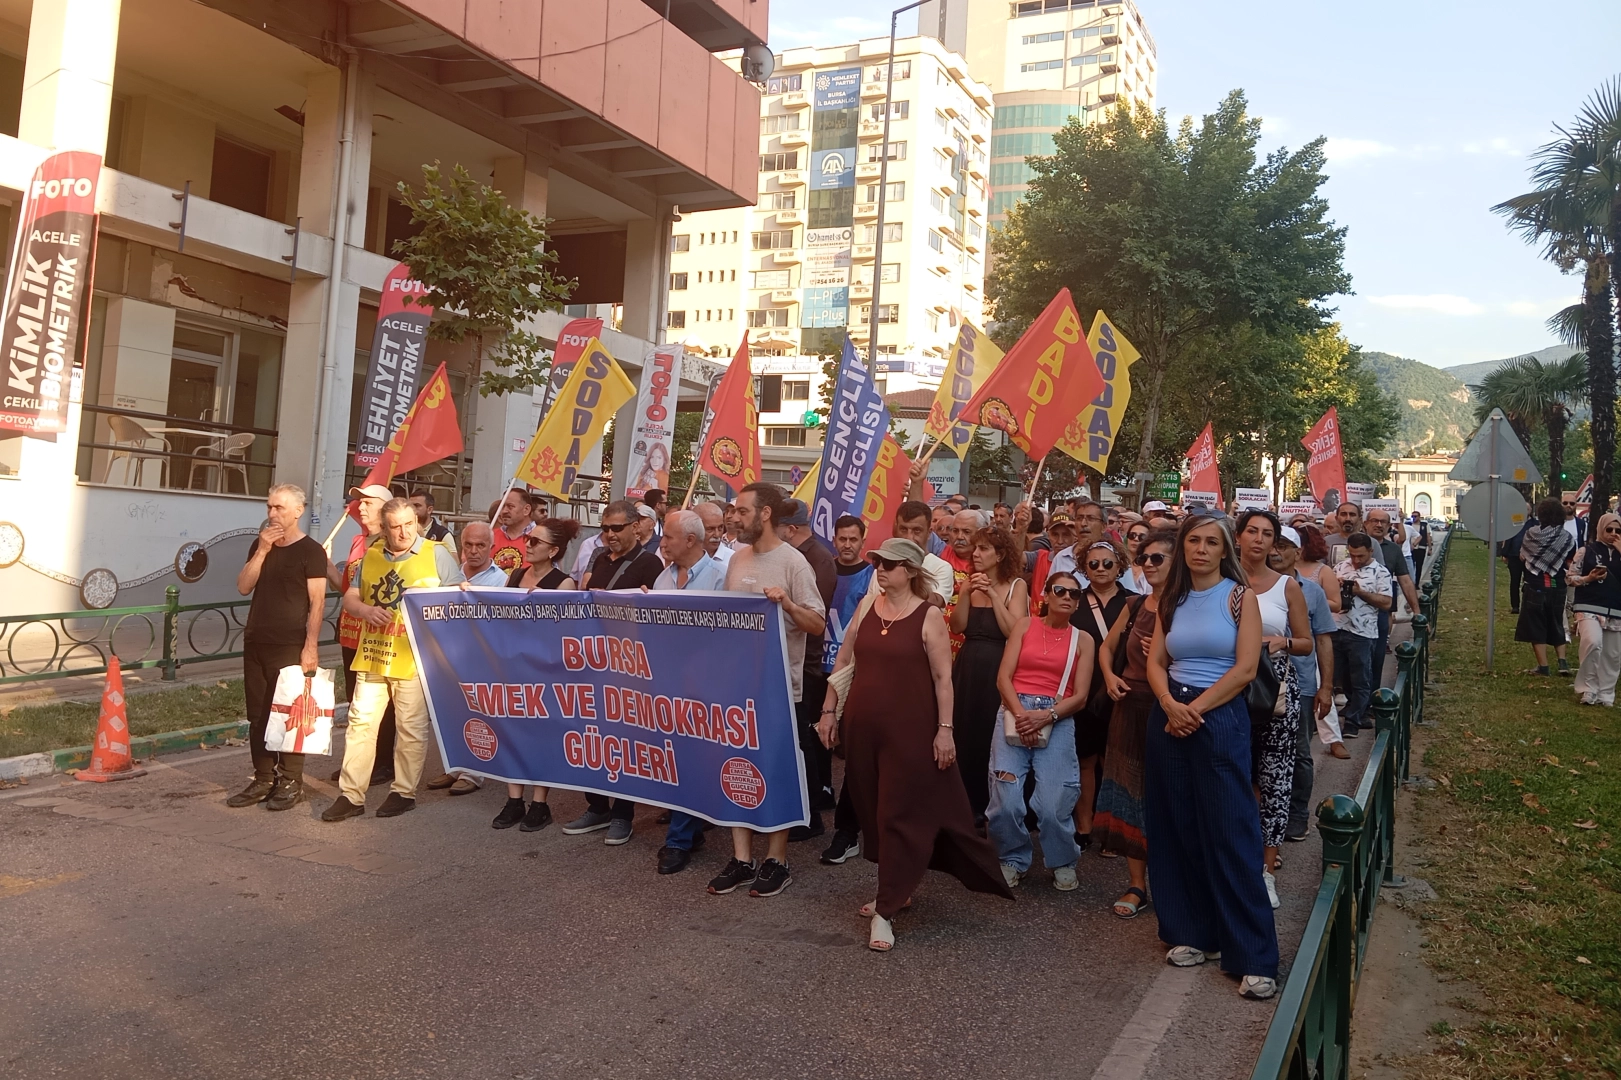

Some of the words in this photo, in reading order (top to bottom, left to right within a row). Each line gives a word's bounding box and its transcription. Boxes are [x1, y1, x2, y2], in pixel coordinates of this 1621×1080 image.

[831, 73, 860, 82] MEMLEKET
[817, 98, 822, 107] İL
[823, 97, 856, 106] BAŞKANLIĞI
[30, 178, 92, 200] FOTO
[30, 230, 81, 246] ACELE
[822, 289, 844, 301] Plus
[822, 309, 844, 321] Plus
[382, 318, 423, 335] ACELE
[561, 351, 611, 494] SODAP
[862, 439, 898, 541] BADİ
[422, 606, 448, 621] EMEK,
[448, 602, 491, 621] ÖZGÜRLÜK,
[491, 602, 536, 621] DEMOKRASİ,
[536, 604, 560, 623] BARIŞ,
[560, 602, 586, 619] LAİKLİK
[651, 606, 693, 626] TEHDİTLERE
[693, 611, 716, 630] KARŞI
[716, 609, 730, 628] BİR
[730, 613, 765, 631] ARADAYIZ
[562, 635, 653, 680] BURSA
[459, 683, 549, 718] EMEK
[553, 684, 597, 719] VE
[603, 685, 760, 750] DEMOKRASİ
[563, 725, 680, 787] GÜÇLERİ
[724, 775, 761, 786] DEMOKRASİ
[733, 794, 757, 805] BEDG
